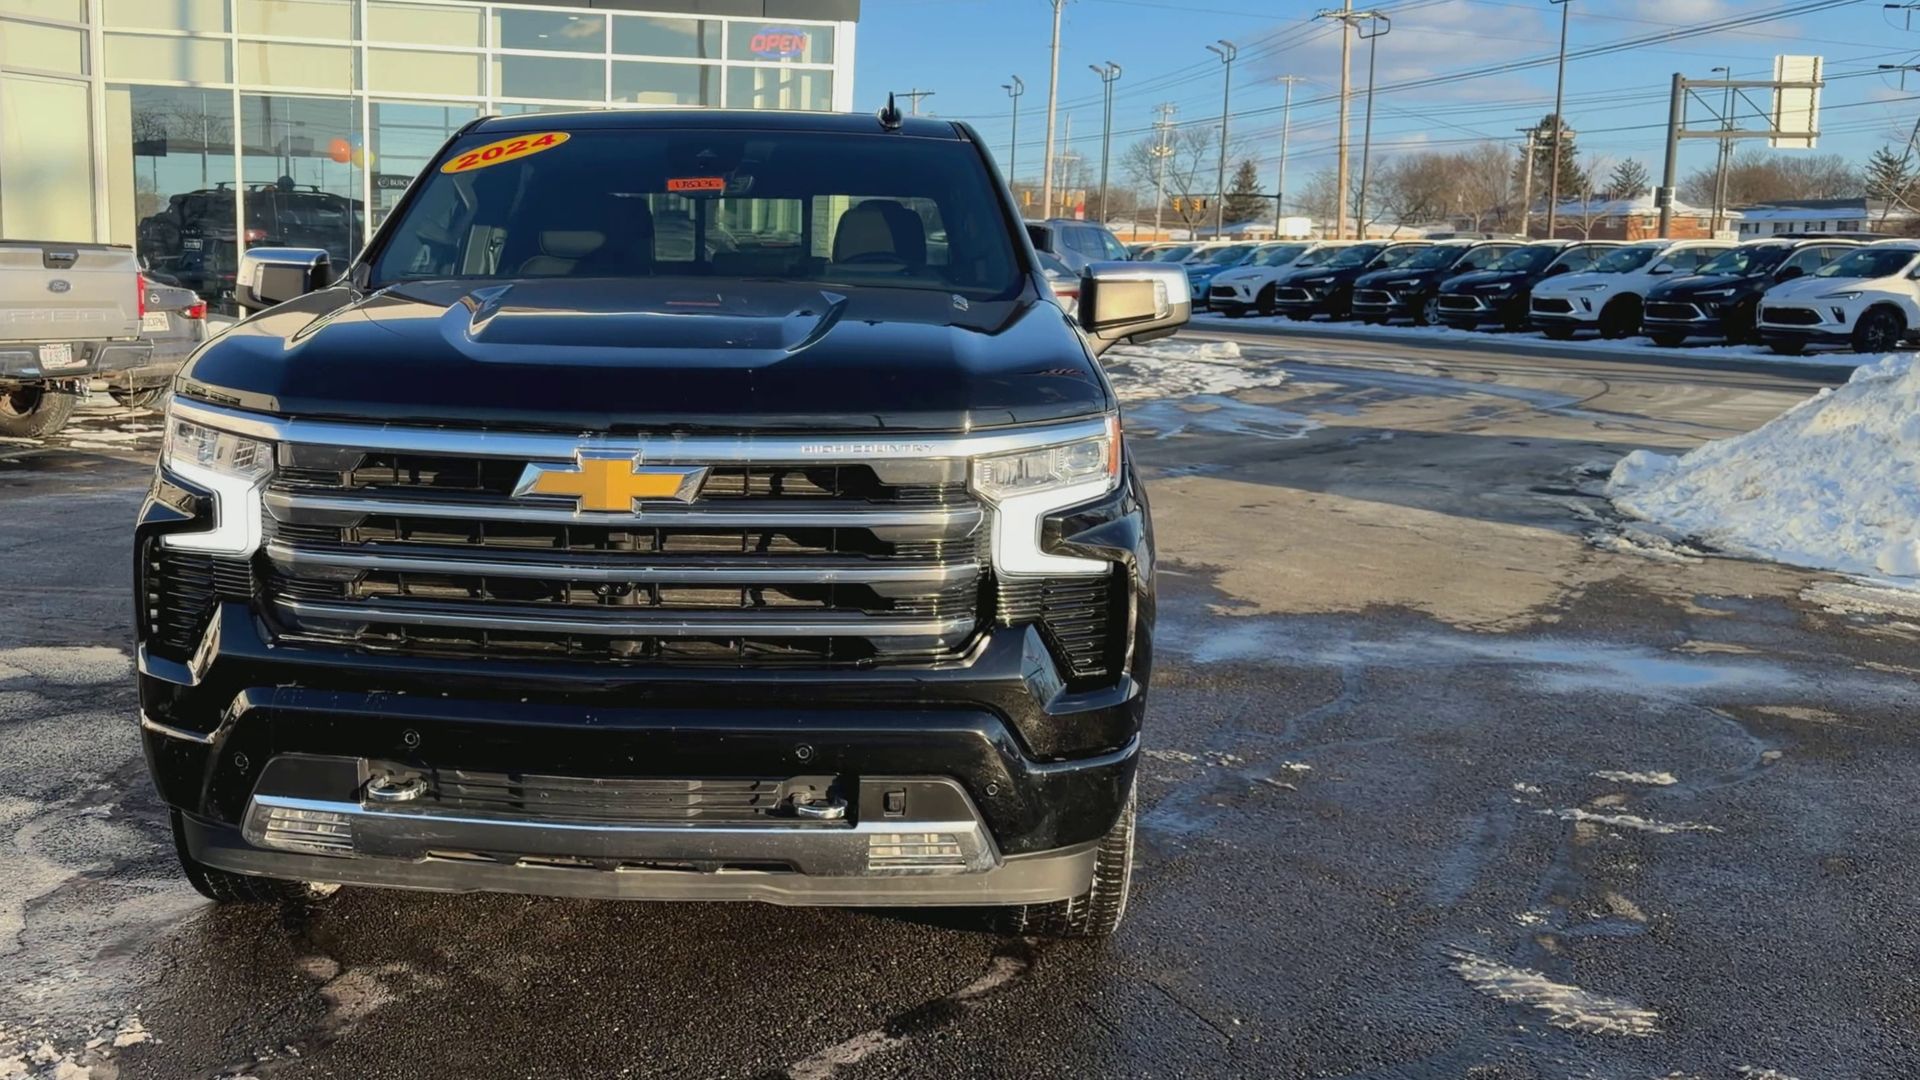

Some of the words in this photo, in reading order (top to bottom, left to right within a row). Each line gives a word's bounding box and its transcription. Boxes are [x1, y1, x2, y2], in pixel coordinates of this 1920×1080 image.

[751, 33, 807, 52] OPEN
[455, 134, 557, 170] 2024
[801, 444, 844, 454] HIGH
[850, 444, 937, 454] COUNTRY
